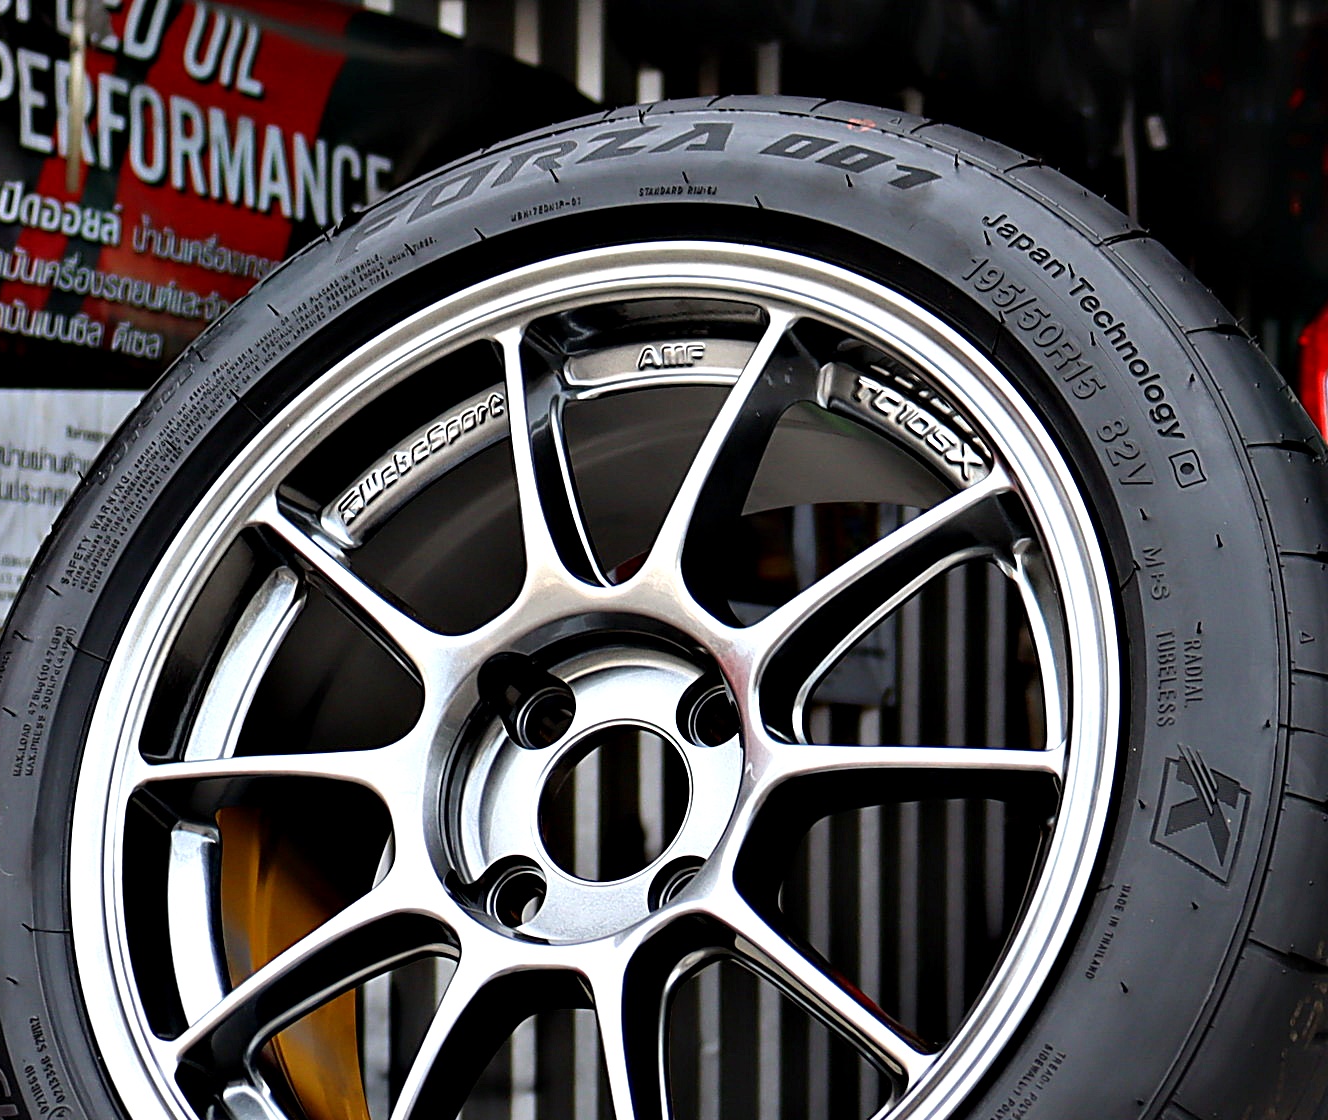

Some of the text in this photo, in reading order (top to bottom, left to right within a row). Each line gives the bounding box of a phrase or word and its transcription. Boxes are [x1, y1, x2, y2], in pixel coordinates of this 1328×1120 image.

[333, 122, 943, 265] FORZA 001
[638, 183, 684, 198] STANDARD
[982, 211, 1186, 442] Japan Technology
[963, 255, 1154, 489] 195/50R15 82V
[58, 535, 93, 585] SAFETY
[1153, 627, 1178, 728] TUBELESS
[1182, 636, 1204, 709] RADIAL
[1112, 884, 1132, 912] MADE
[1082, 930, 1115, 981] THAILAND
